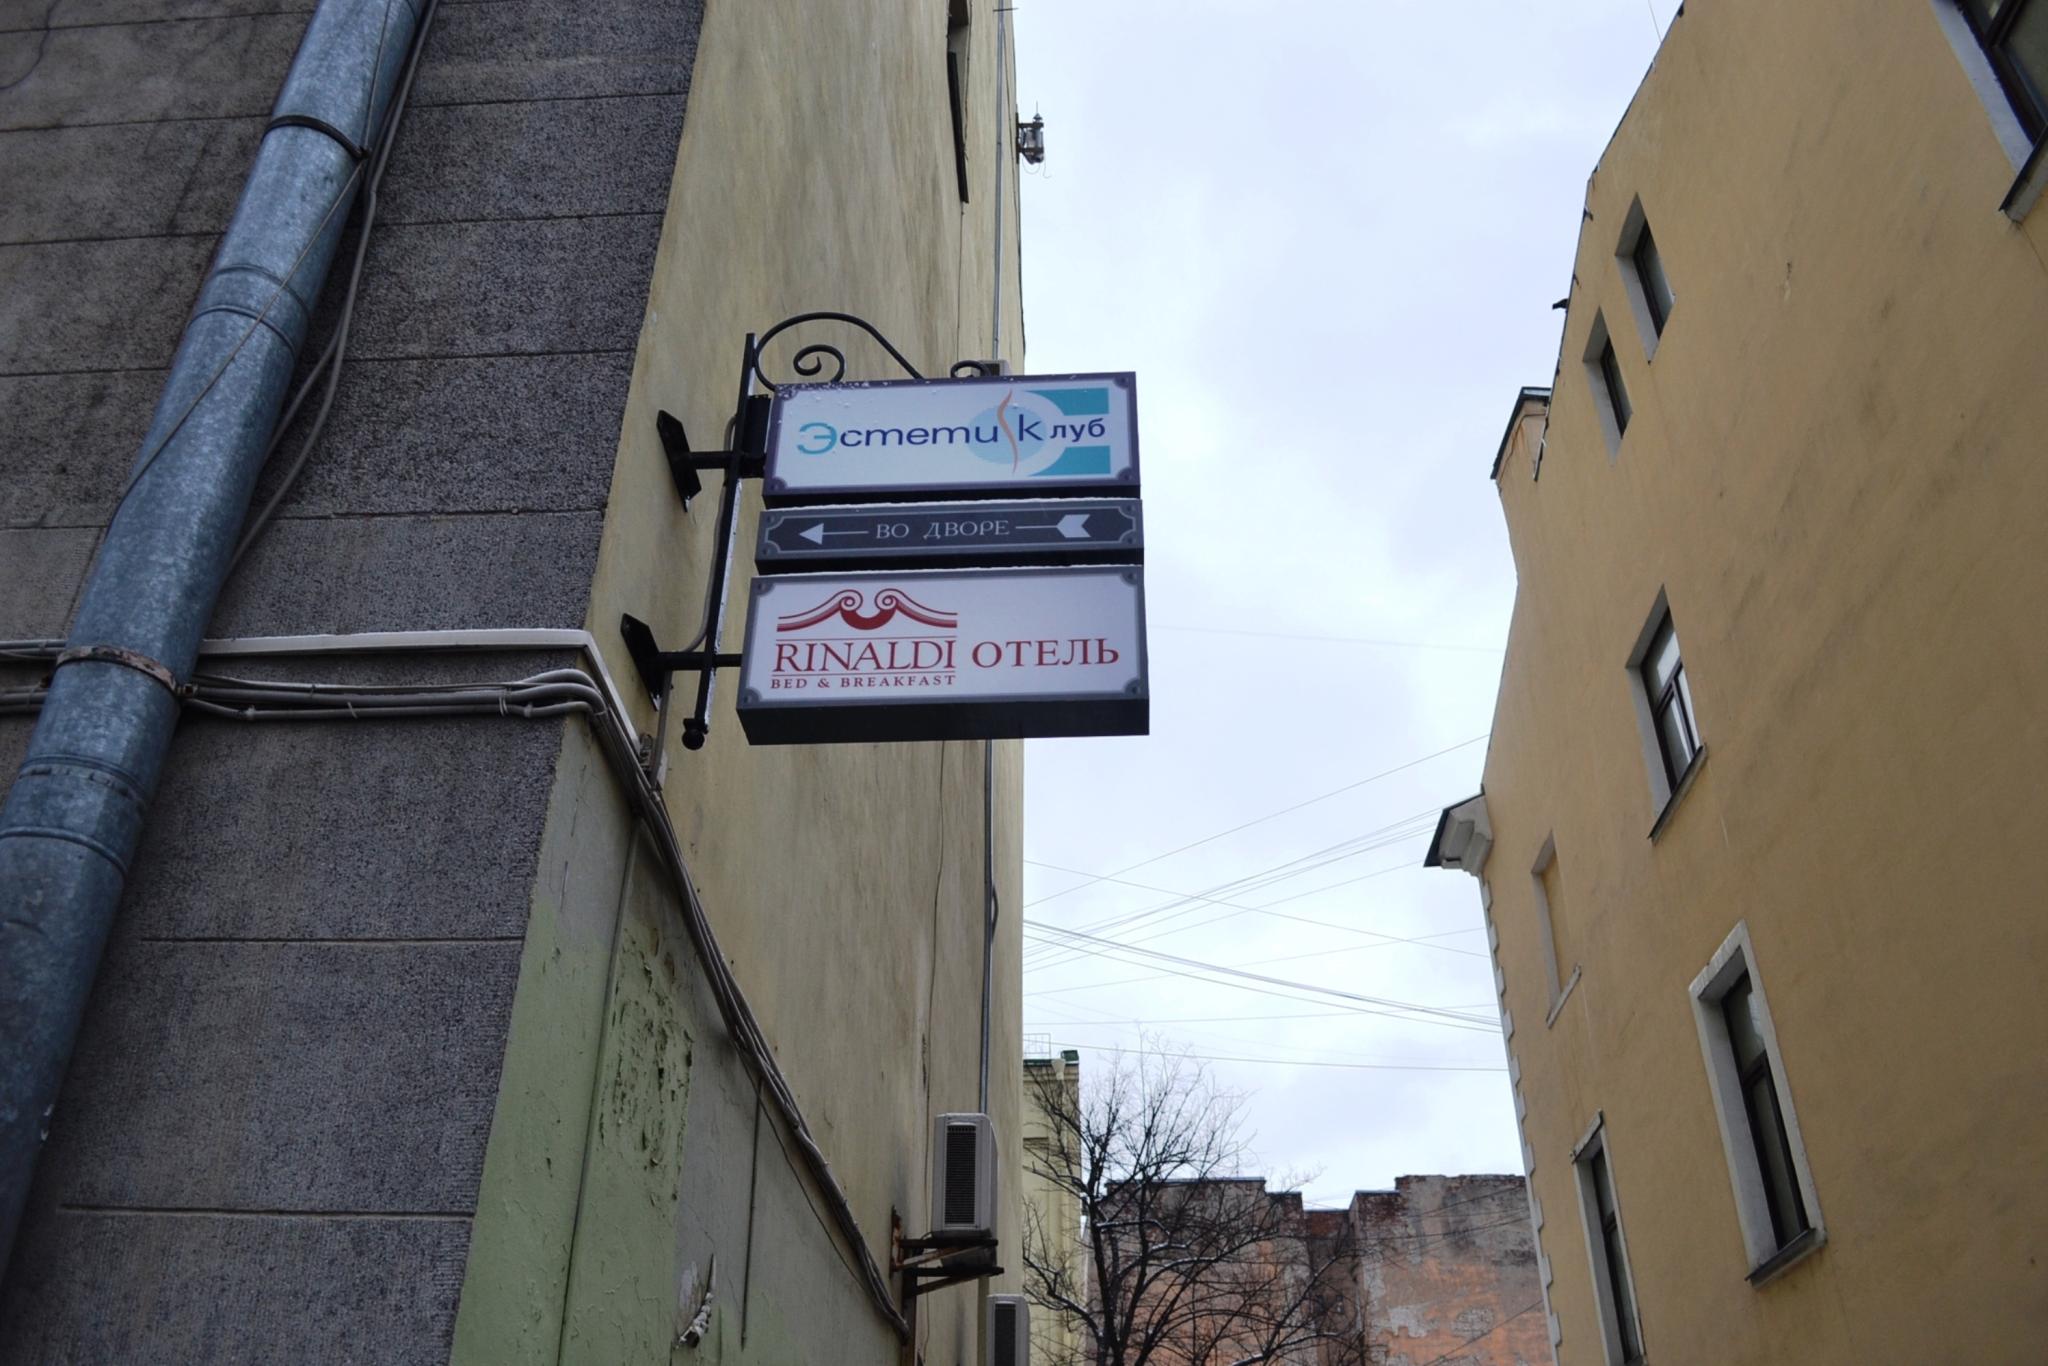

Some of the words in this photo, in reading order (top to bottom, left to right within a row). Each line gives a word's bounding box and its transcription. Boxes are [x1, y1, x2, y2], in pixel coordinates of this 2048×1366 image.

[876, 523, 910, 540] ВО
[923, 520, 1011, 541] ДВОРЕ
[772, 640, 956, 673] RINALDI
[971, 637, 1120, 669] ОТЕЛЬ
[770, 676, 808, 690] BED
[817, 676, 831, 689] &
[841, 674, 956, 689] BREAKFAST
